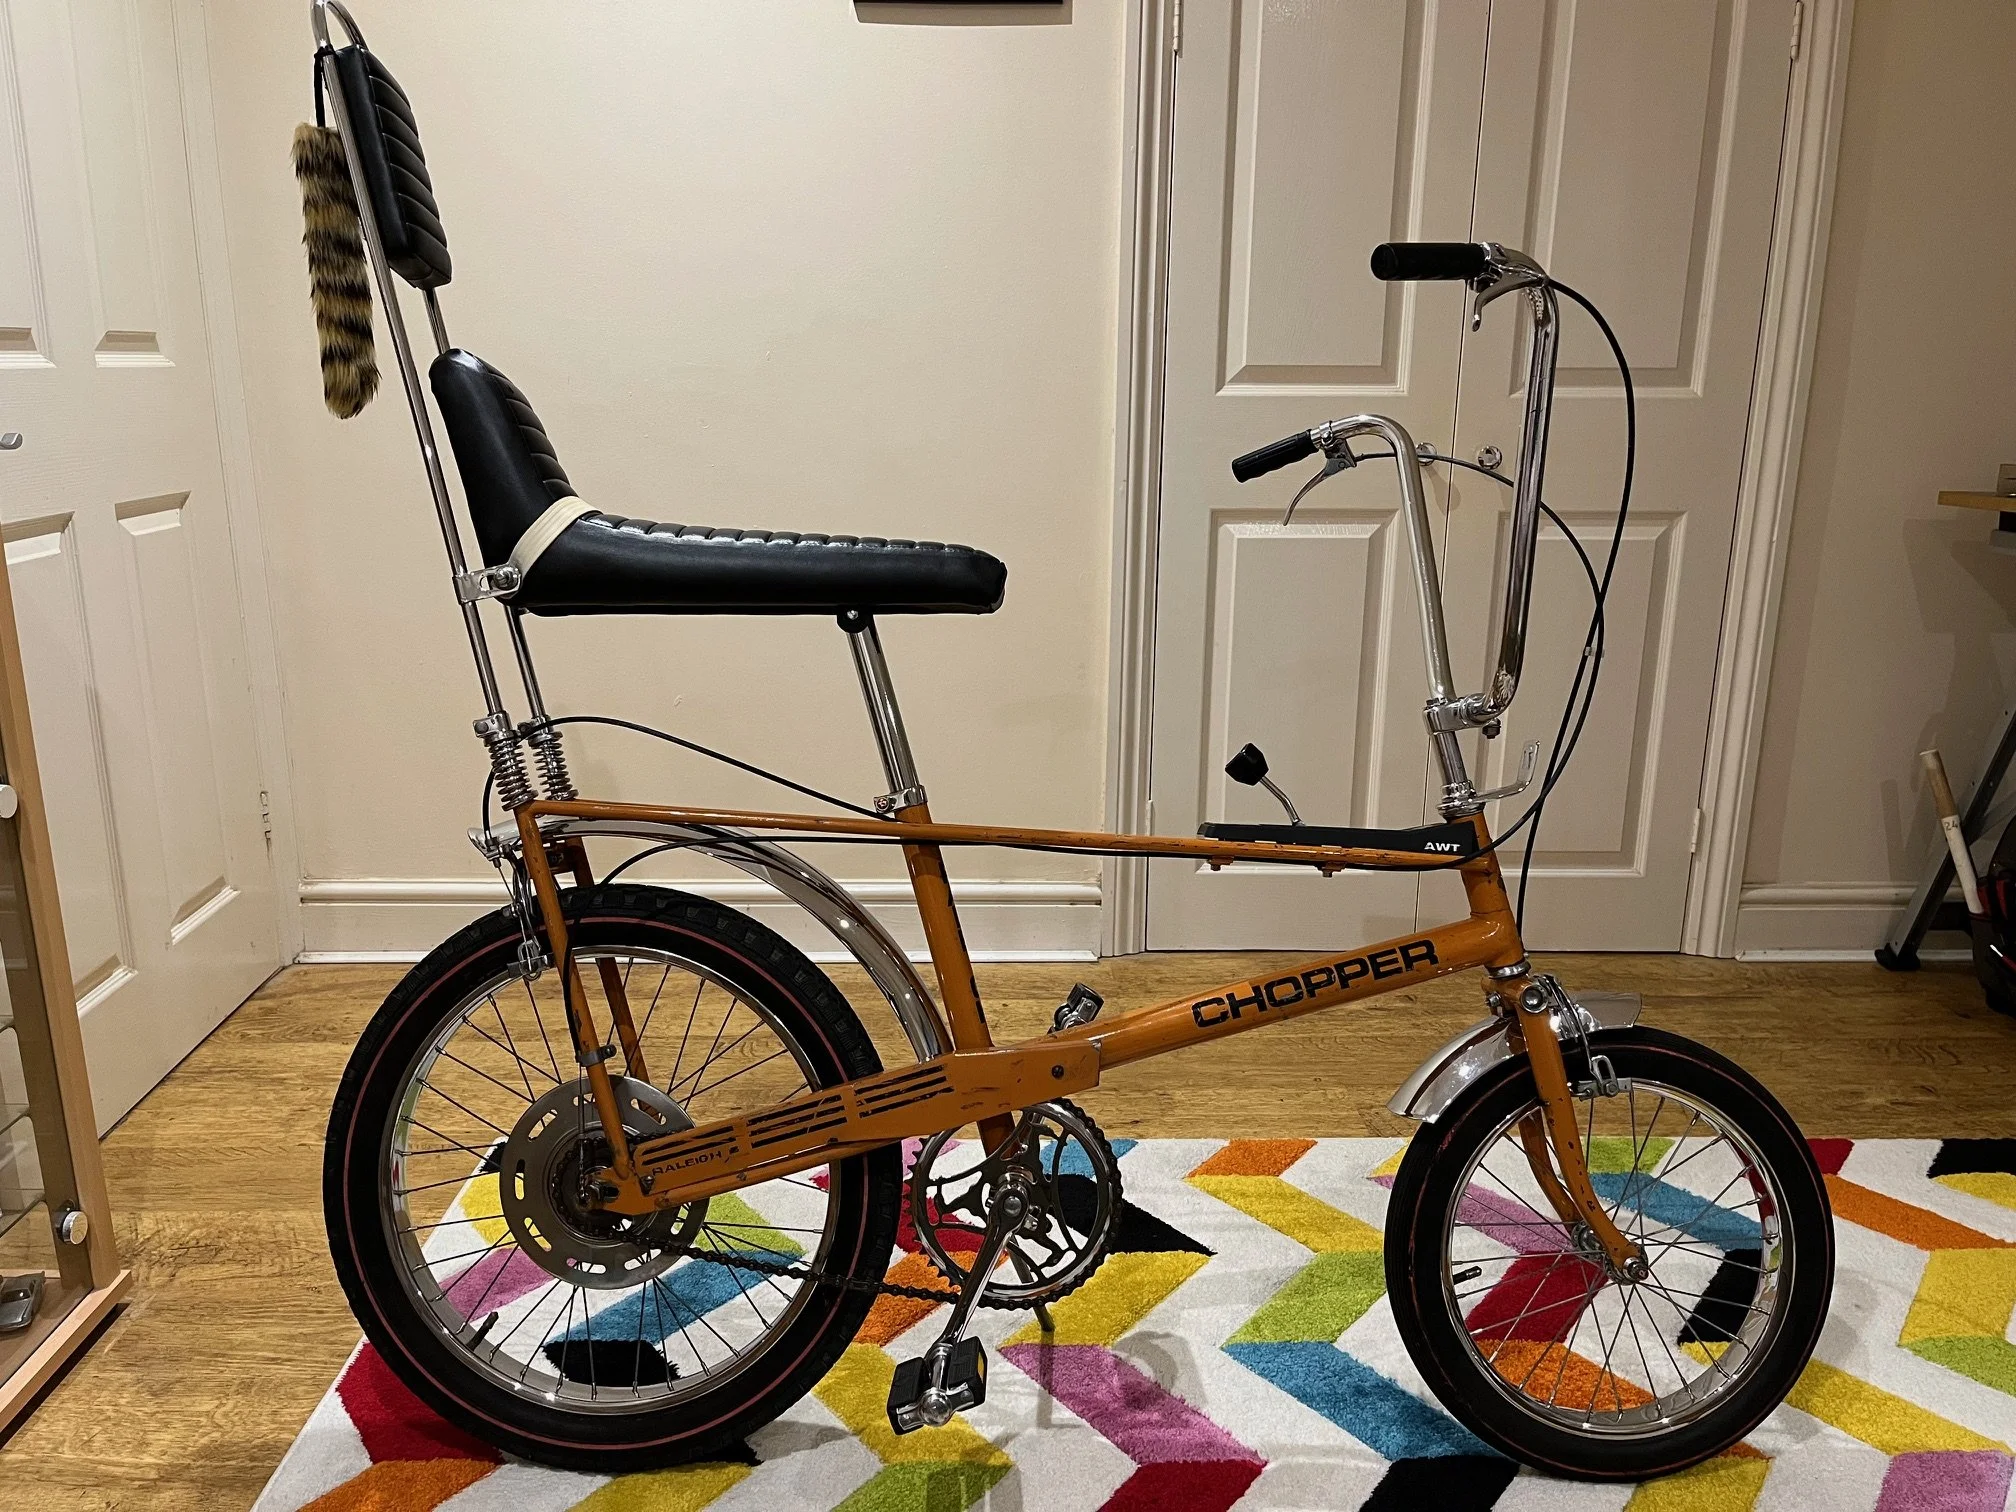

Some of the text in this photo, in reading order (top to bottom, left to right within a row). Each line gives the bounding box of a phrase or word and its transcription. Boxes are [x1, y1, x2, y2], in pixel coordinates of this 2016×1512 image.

[1423, 841, 1461, 852] AWT
[1191, 939, 1439, 1028] CHOPPER
[651, 1150, 723, 1176] RALEIGH
